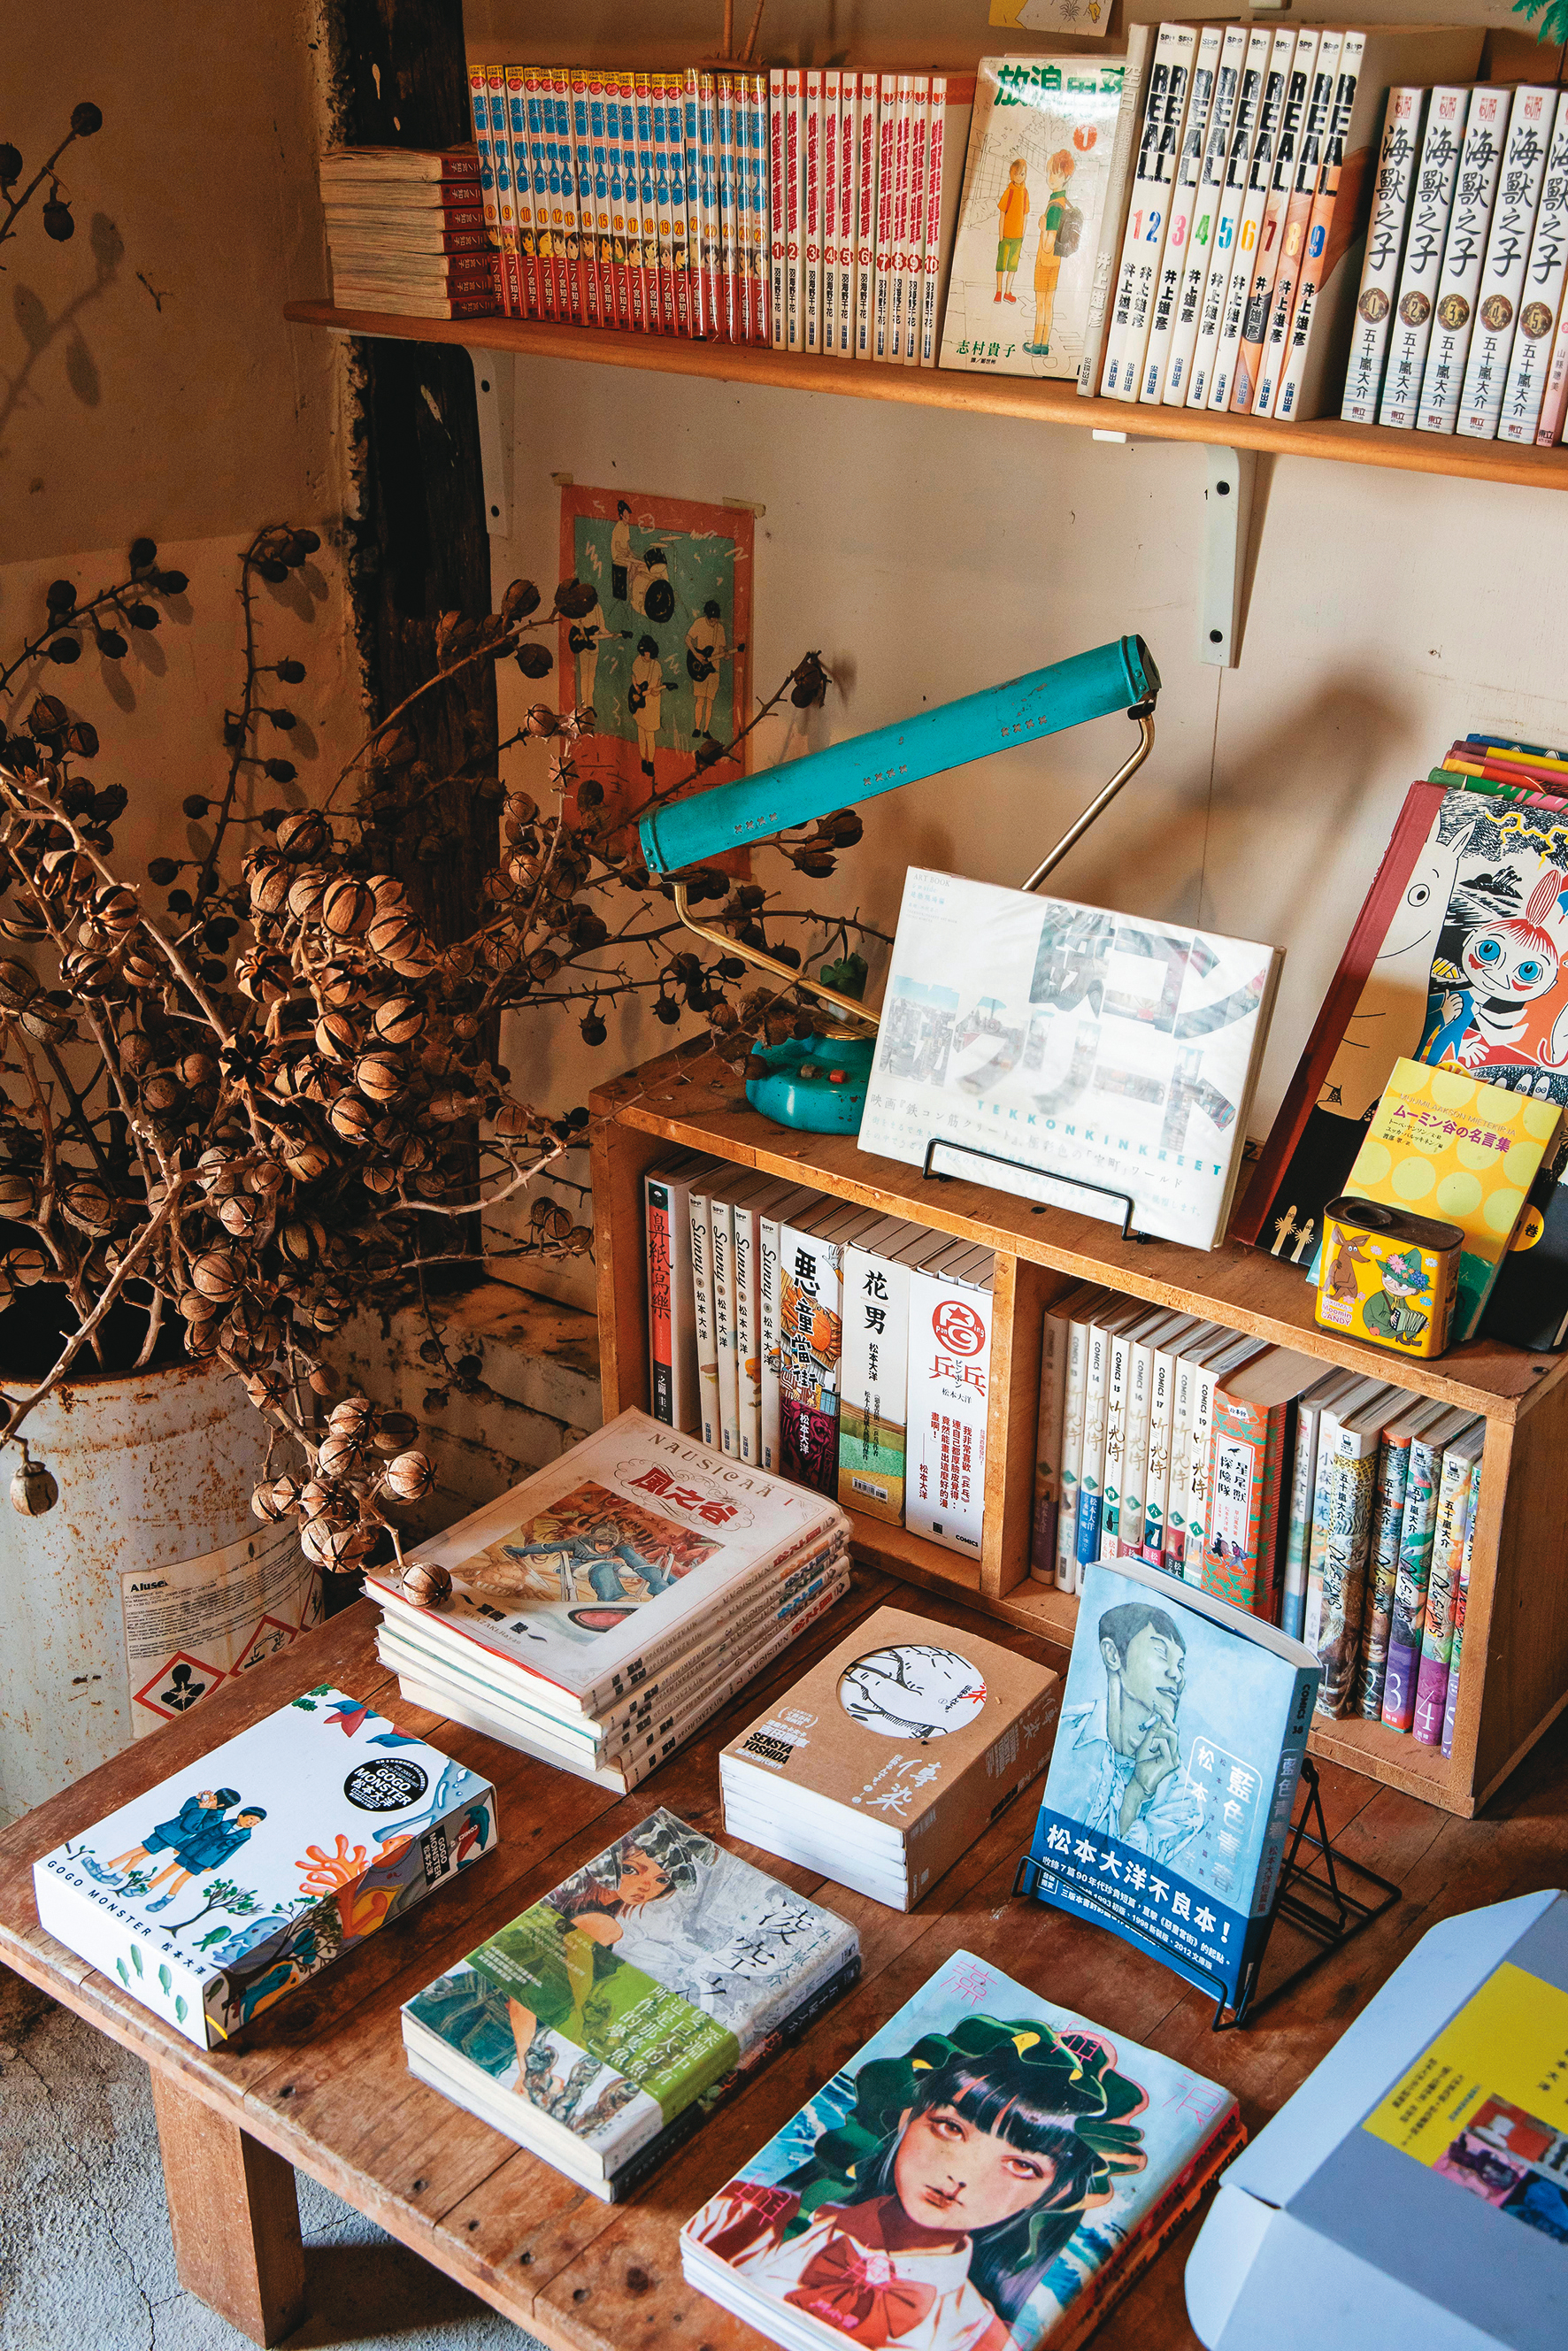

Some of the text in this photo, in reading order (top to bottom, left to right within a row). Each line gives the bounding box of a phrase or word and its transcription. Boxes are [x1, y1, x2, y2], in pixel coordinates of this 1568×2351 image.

[1136, 64, 1170, 181] REAL
[1155, 65, 1188, 184] REAL
[1178, 68, 1213, 188] REAL
[1202, 66, 1237, 187] REAL
[1226, 69, 1261, 189] REAL
[1249, 71, 1285, 192] REAL
[1272, 71, 1307, 193] REAL
[1295, 73, 1333, 196] REAL
[1318, 73, 1357, 196] REAL
[1368, 124, 1414, 272] 海獸之子
[1410, 125, 1458, 274] 海獸之子
[1449, 127, 1499, 278] 海獸之子
[1492, 126, 1544, 278] 海獸之子
[1133, 209, 1143, 239] 1
[1146, 211, 1162, 243] 2
[1172, 215, 1187, 246] 3
[1195, 214, 1211, 245] 4
[1218, 217, 1234, 249] 5
[1241, 219, 1257, 252] 6
[1264, 219, 1278, 252] 7
[1285, 222, 1302, 257] 8
[1309, 225, 1326, 257] 9
[956, 340, 1017, 358] 志村貴子
[1356, 329, 1377, 399] 五十嵐大介
[1395, 332, 1417, 403] 五十嵐大介
[1433, 335, 1456, 408] 五十嵐大介
[1474, 336, 1497, 409] 五十嵐大介
[1512, 344, 1537, 417] 五十嵐大介
[977, 1100, 1221, 1176] TEKKONKINKREET
[1393, 1104, 1512, 1153] ムーミン谷の名言集
[692, 1218, 706, 1275] Sunny
[713, 1225, 727, 1283] Sunny
[735, 1232, 750, 1289] Sunny
[761, 1243, 777, 1301] Sunny
[696, 1291, 708, 1340] 松本大洋
[717, 1298, 728, 1348] 松本大洋
[862, 1270, 889, 1335] 花男
[1322, 1311, 1349, 1326] CANDY
[739, 1304, 749, 1354] 松本大洋
[868, 1342, 880, 1381] 松本大洋
[929, 1355, 987, 1397] 乒乓
[942, 1387, 972, 1403] 松本大洋
[799, 1413, 811, 1454] 松本大洋
[648, 1433, 775, 1498] NAUSICAÄ
[919, 1464, 928, 1500] 松本大洋
[628, 1467, 739, 1525] 風之谷
[1337, 1472, 1349, 1520] 五十嵐大介
[1380, 1479, 1394, 1525] 五十嵐大介
[1408, 1486, 1421, 1533] 五十嵐大介
[956, 1534, 979, 1548] COMICS
[1441, 1500, 1454, 1548] 五十嵐大介
[1296, 1683, 1311, 1720] COMICS
[1363, 1668, 1380, 1708] 2
[1385, 1673, 1402, 1712] 3
[1417, 1691, 1434, 1732] 4
[742, 1740, 790, 1764] YOSHIDA
[749, 1732, 794, 1754] SENSYA
[350, 1778, 396, 1807] 松本大洋
[354, 1767, 412, 1806] MONSTER
[376, 1768, 411, 1792] GOGO
[429, 1832, 442, 1878] MONSTER
[437, 1837, 448, 1864] GOGO
[47, 1860, 152, 1937] GOGO MONSTER
[1047, 1824, 1230, 1943] 松本大洋不良本！
[160, 1942, 207, 1975] 松本大洋
